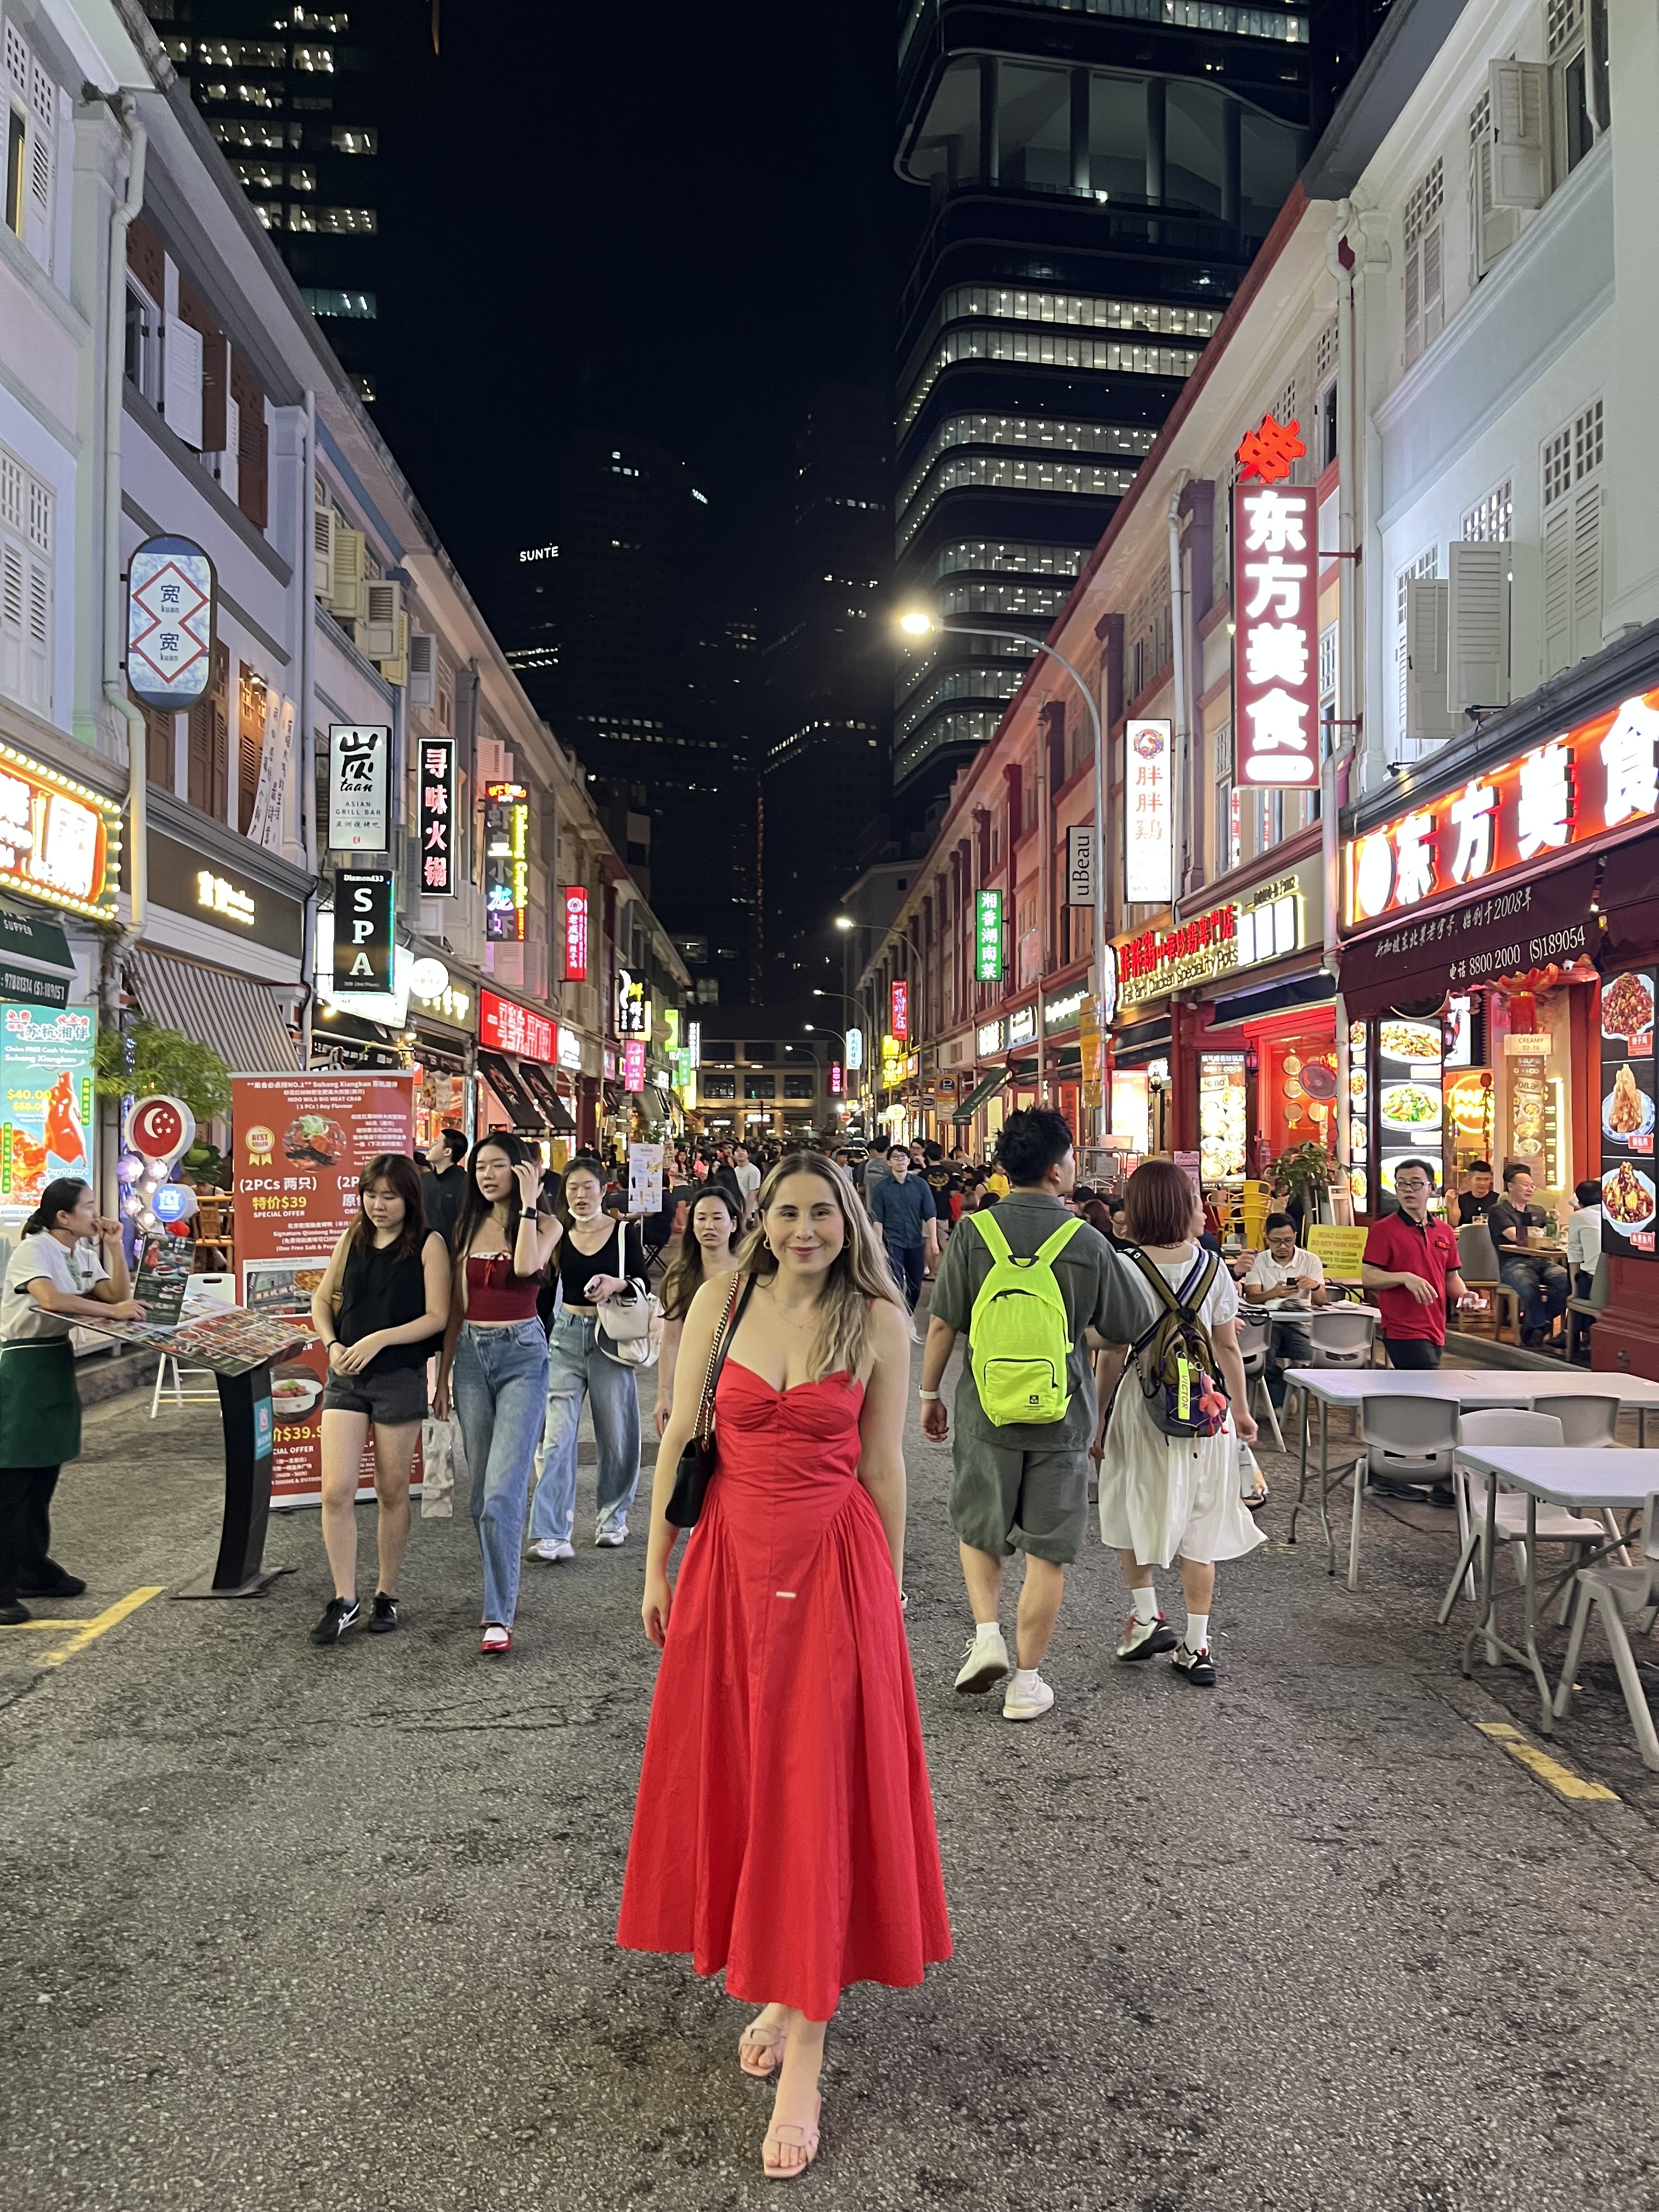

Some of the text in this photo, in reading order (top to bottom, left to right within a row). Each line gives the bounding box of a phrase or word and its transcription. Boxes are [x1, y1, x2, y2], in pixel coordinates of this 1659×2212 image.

[520, 546, 559, 562] SUNTE
[161, 584, 180, 603] 宽
[161, 605, 180, 613] kuan
[1244, 490, 1310, 752] 东方美食
[160, 633, 179, 651] 宽
[160, 652, 178, 661] kuan
[340, 778, 373, 792] taan
[1395, 695, 1659, 906] 东方美食
[335, 821, 381, 829] 亚洲烧烤吧
[425, 748, 448, 887] 寻味火锅
[1072, 835, 1090, 896] uBeau
[4, 919, 33, 936] SUPPER
[349, 888, 375, 976] SPA
[981, 892, 997, 979] 湘香湖南菜
[1449, 926, 1586, 981] 电话 8800 2000 (S)189054
[25, 1024, 88, 1040] 苏杭湘伴
[7, 1088, 52, 1101] $40.00
[240, 1176, 360, 1193] (2PCs 两只) (2P
[252, 1195, 307, 1210] 特价$39
